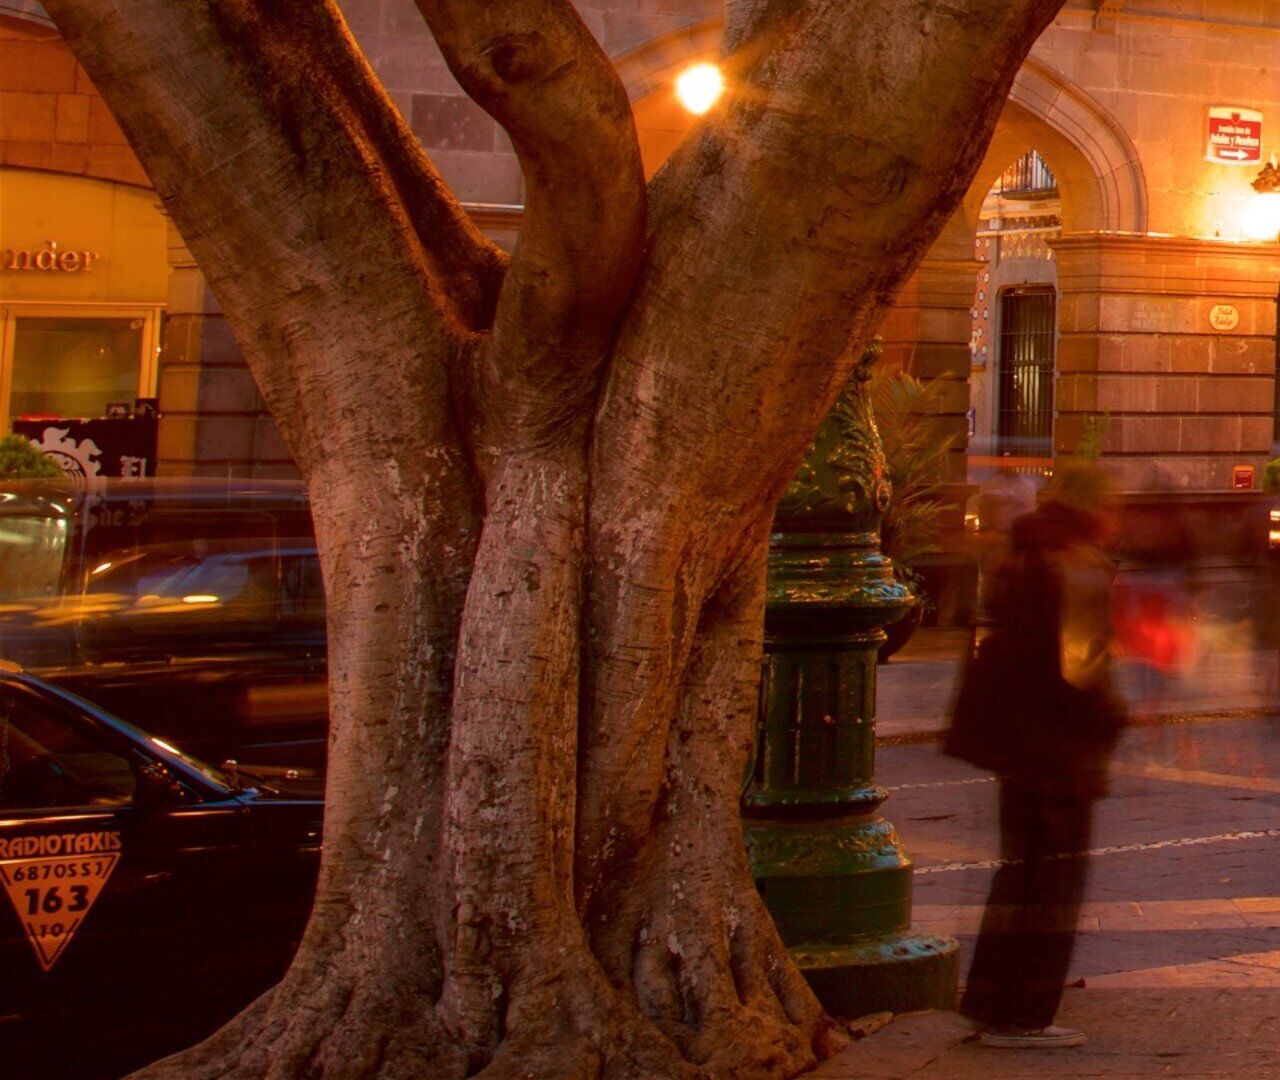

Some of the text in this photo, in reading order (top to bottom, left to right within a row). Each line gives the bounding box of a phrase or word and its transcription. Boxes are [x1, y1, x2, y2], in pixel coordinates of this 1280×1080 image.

[0, 240, 100, 272] nder
[0, 831, 121, 858] RADIOTAXIS
[25, 885, 89, 915] 163
[40, 923, 64, 938] 10
